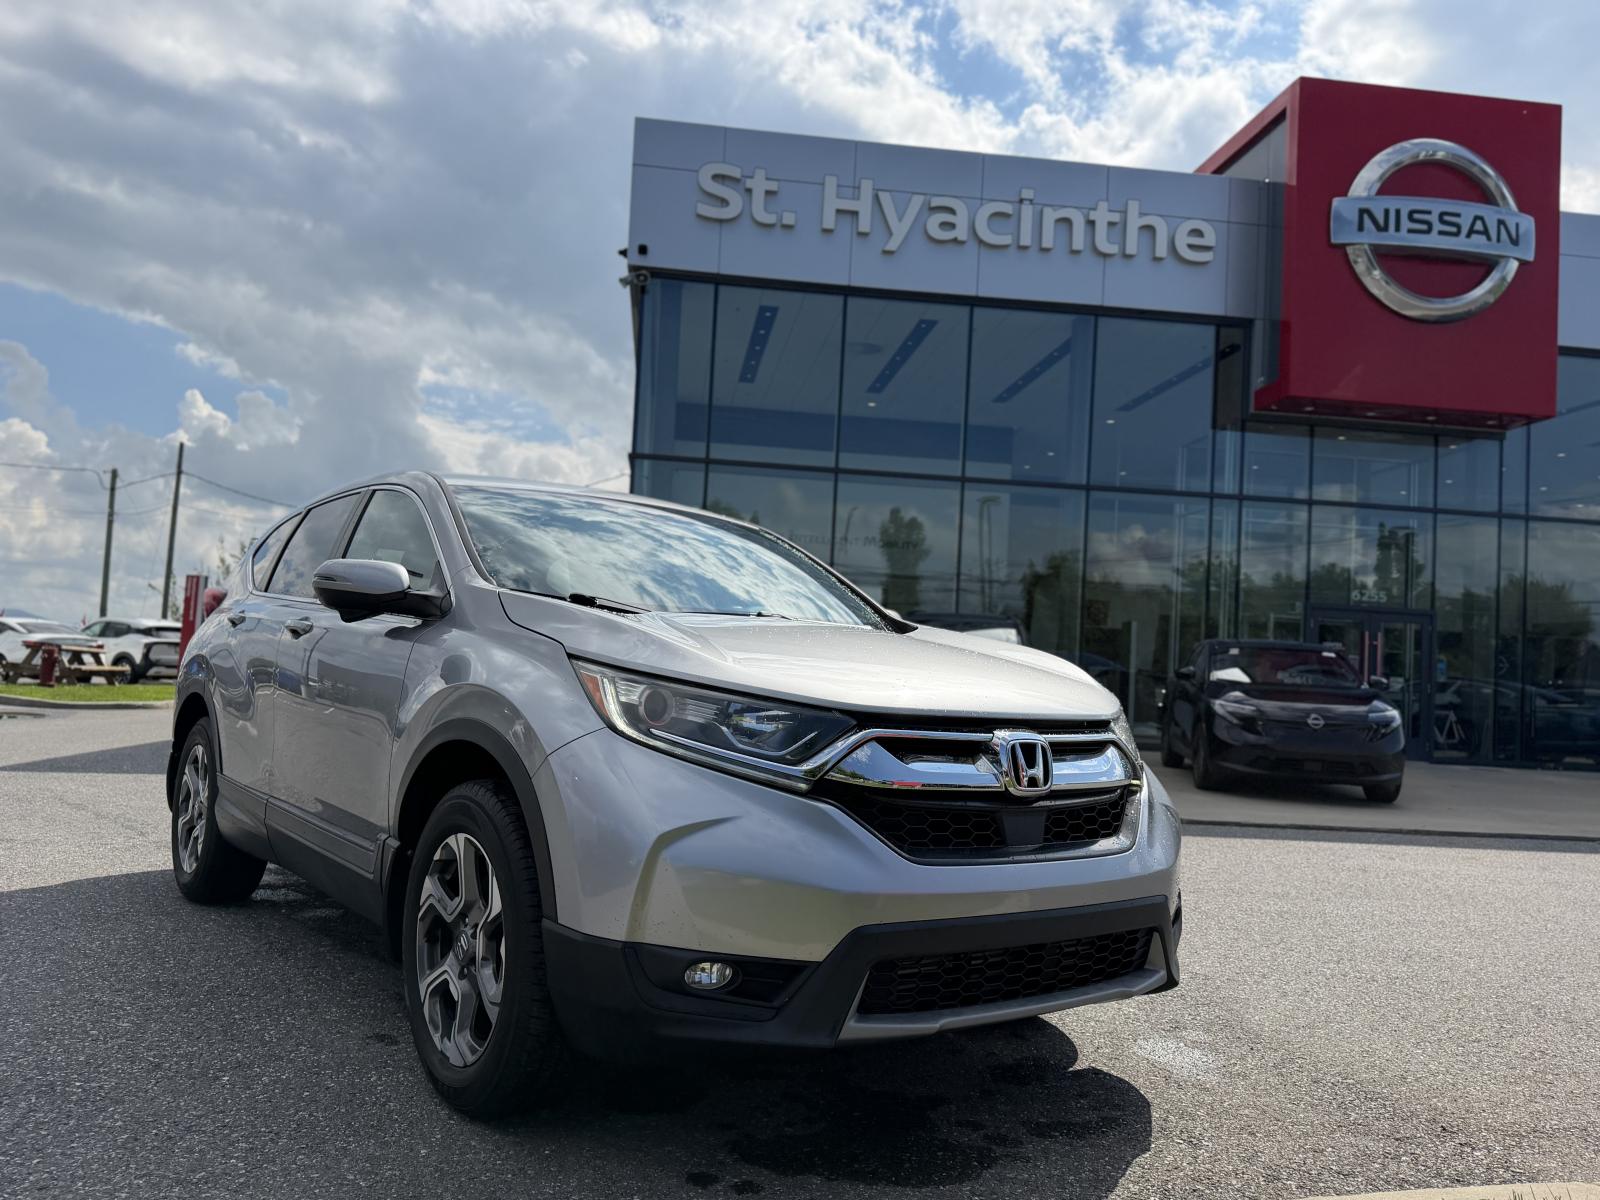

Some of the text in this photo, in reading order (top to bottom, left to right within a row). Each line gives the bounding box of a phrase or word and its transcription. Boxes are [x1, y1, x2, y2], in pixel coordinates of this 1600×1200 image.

[696, 162, 1217, 263] St. Hyacinthe
[1357, 207, 1520, 247] NISSAN
[1351, 589, 1387, 602] 6255
